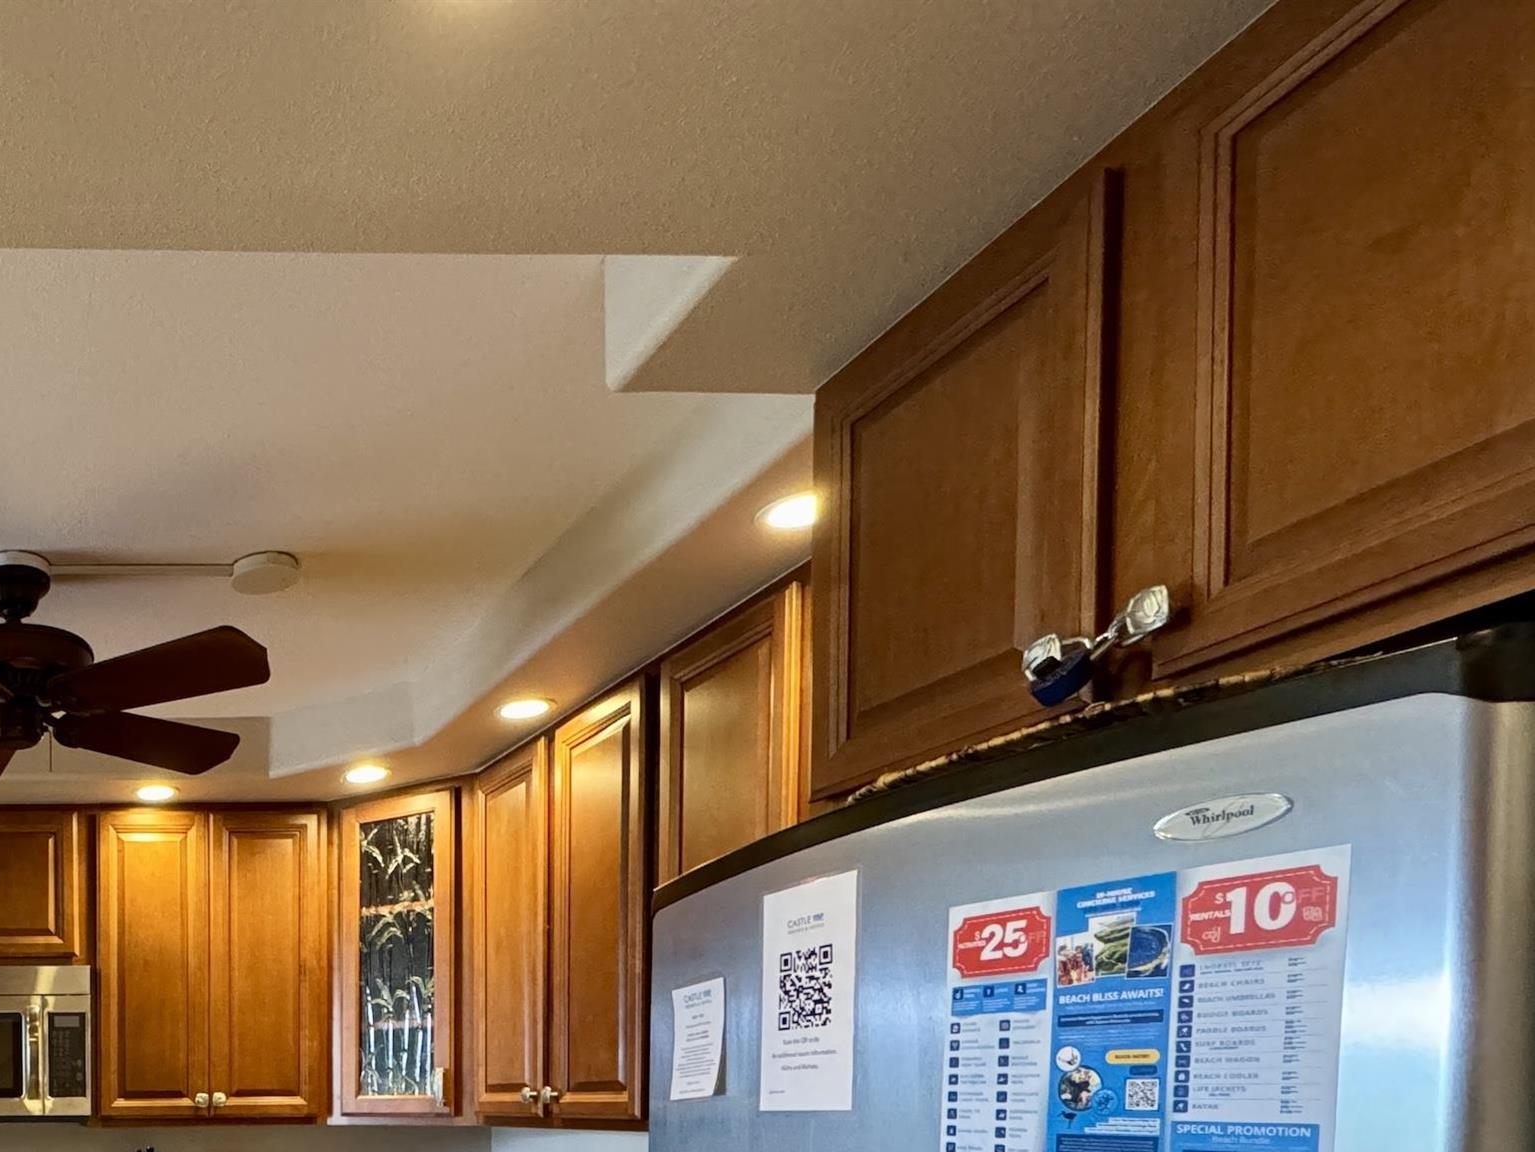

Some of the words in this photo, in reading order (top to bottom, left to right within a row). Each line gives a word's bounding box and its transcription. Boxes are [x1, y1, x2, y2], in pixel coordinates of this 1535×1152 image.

[1190, 805, 1255, 826] Whirlpool
[787, 915, 811, 929] CASTLE
[1189, 910, 1231, 921] RENTALS
[1059, 994, 1090, 1004] BEACH
[1092, 991, 1119, 1002] BLISS
[1120, 988, 1164, 999] AWAITS!
[1176, 1124, 1224, 1135] SPECIAL
[1227, 1126, 1312, 1138] PROMOTION
